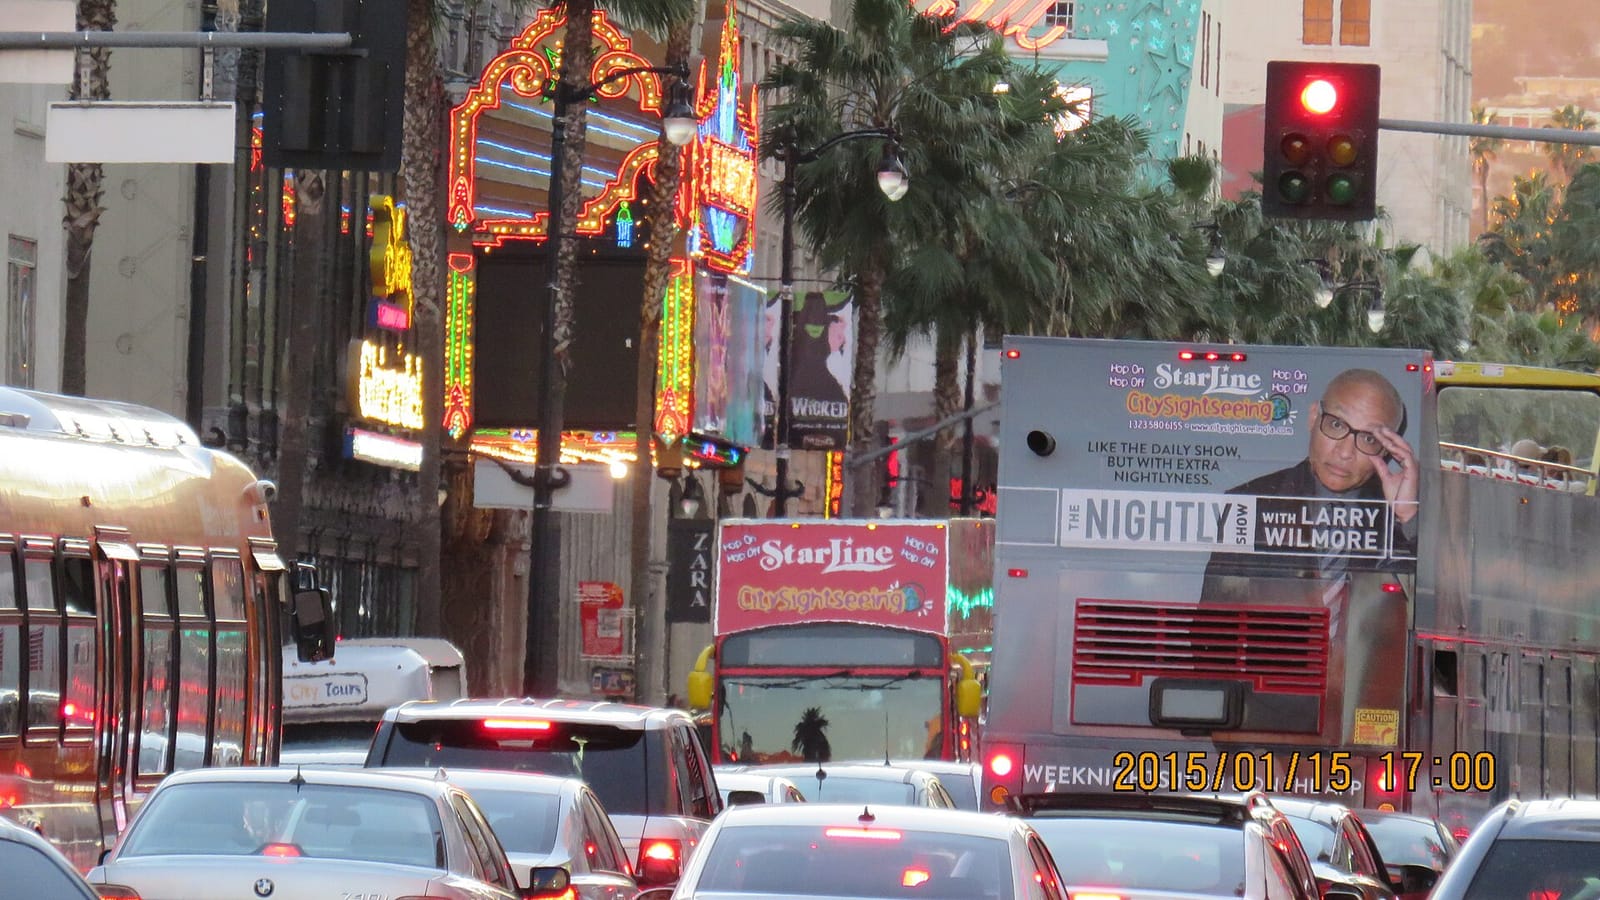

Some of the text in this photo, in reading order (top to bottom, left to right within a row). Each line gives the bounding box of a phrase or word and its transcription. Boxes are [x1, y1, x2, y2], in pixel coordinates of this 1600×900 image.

[1110, 363, 1145, 376] Hop On
[1153, 363, 1264, 395] StarLine
[1272, 369, 1307, 381] Hop On
[1109, 377, 1145, 388] Hop Off
[1271, 383, 1308, 394] Hop Off
[1127, 390, 1273, 425] CitySightseeing
[1088, 441, 1241, 460] LIKE THE DAILY SHOW,
[1107, 456, 1220, 471] BUT WITH EXTRA
[1114, 471, 1213, 485] NIGHTLYNESS.
[1068, 498, 1249, 545] THE NIGHTLY SHOW
[1262, 506, 1380, 528] WITH LARRY
[723, 535, 757, 551] Hop On
[904, 536, 939, 555] Hop On
[1264, 527, 1379, 550] WILMORE
[726, 546, 762, 563] Hop Off
[759, 537, 897, 575] StarLine
[901, 549, 935, 569] Hop Off
[689, 532, 709, 607] ZARA
[737, 585, 906, 614] CitySightseeing
[290, 682, 362, 701] City Tours
[1360, 713, 1394, 723] CAUTION
